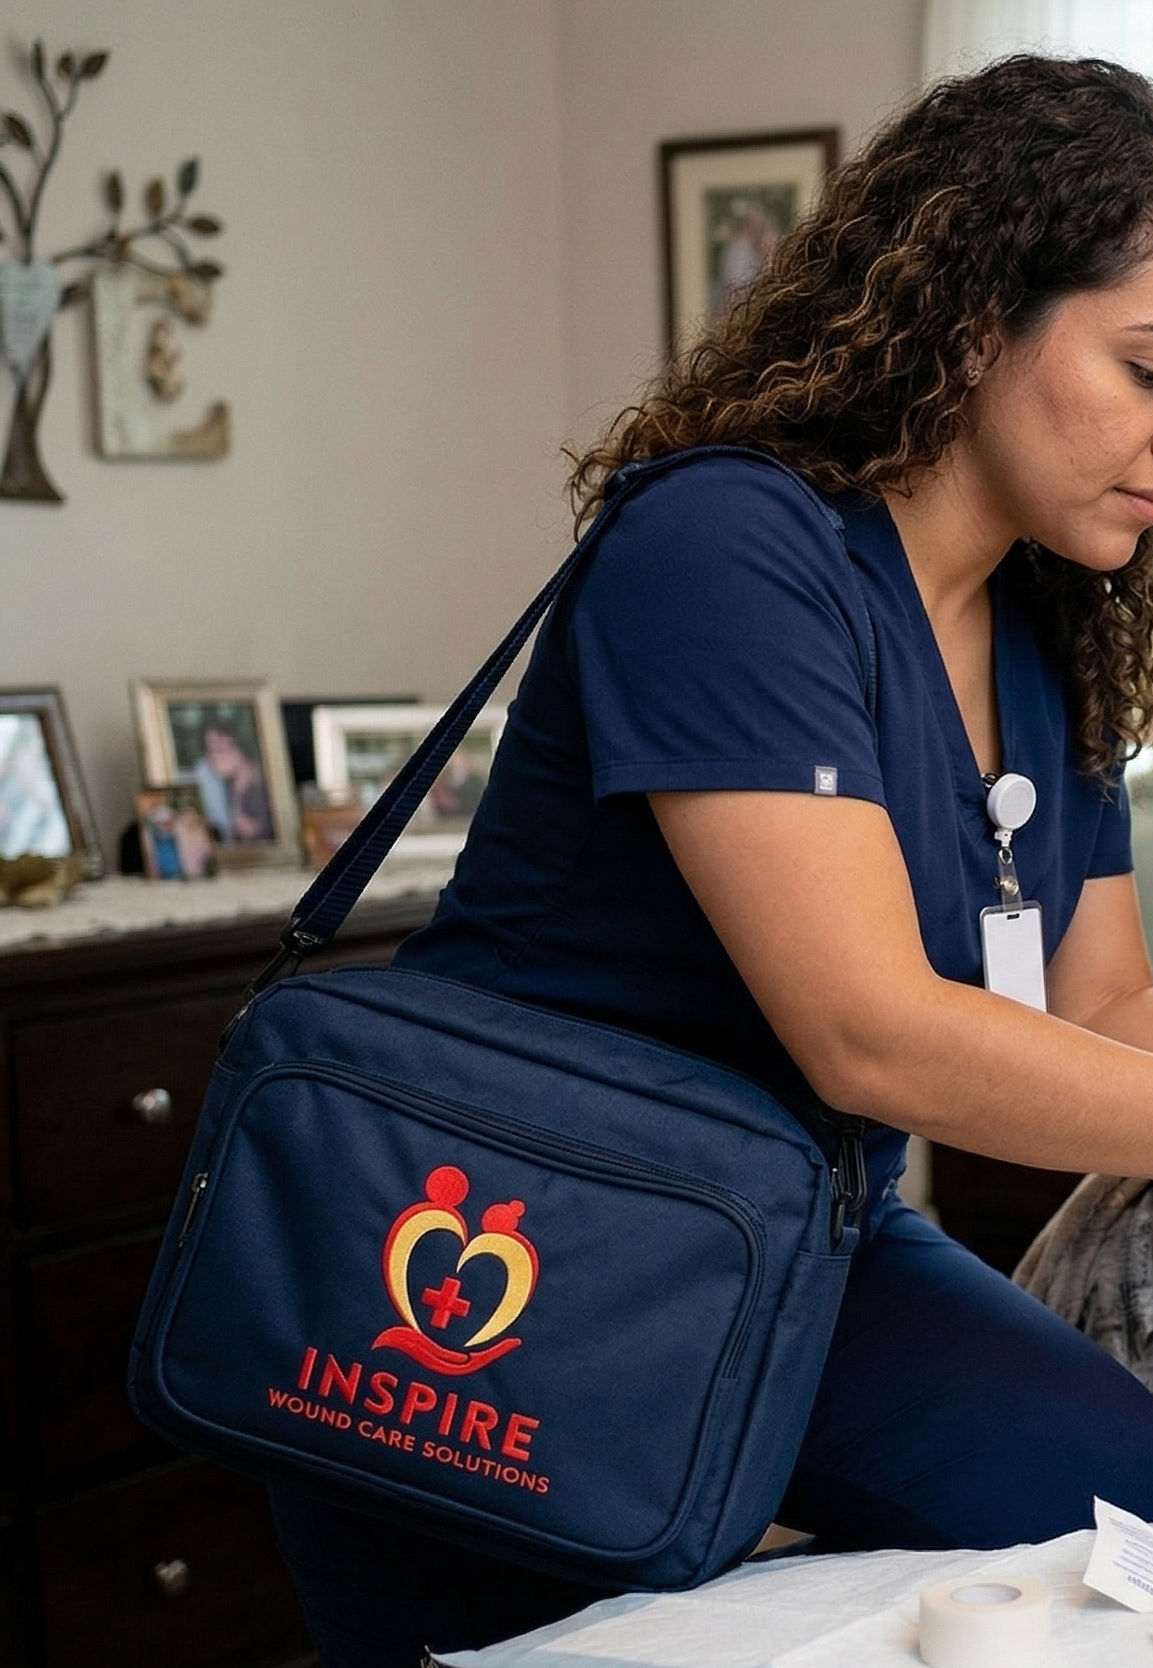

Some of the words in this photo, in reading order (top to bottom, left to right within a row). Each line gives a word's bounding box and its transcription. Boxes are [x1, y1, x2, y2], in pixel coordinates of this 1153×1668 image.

[268, 1388, 351, 1429] WOUND
[357, 1421, 416, 1452] CARE
[422, 1441, 550, 1494] SOLUTIONS
[297, 1347, 540, 1461] INSPIRE
